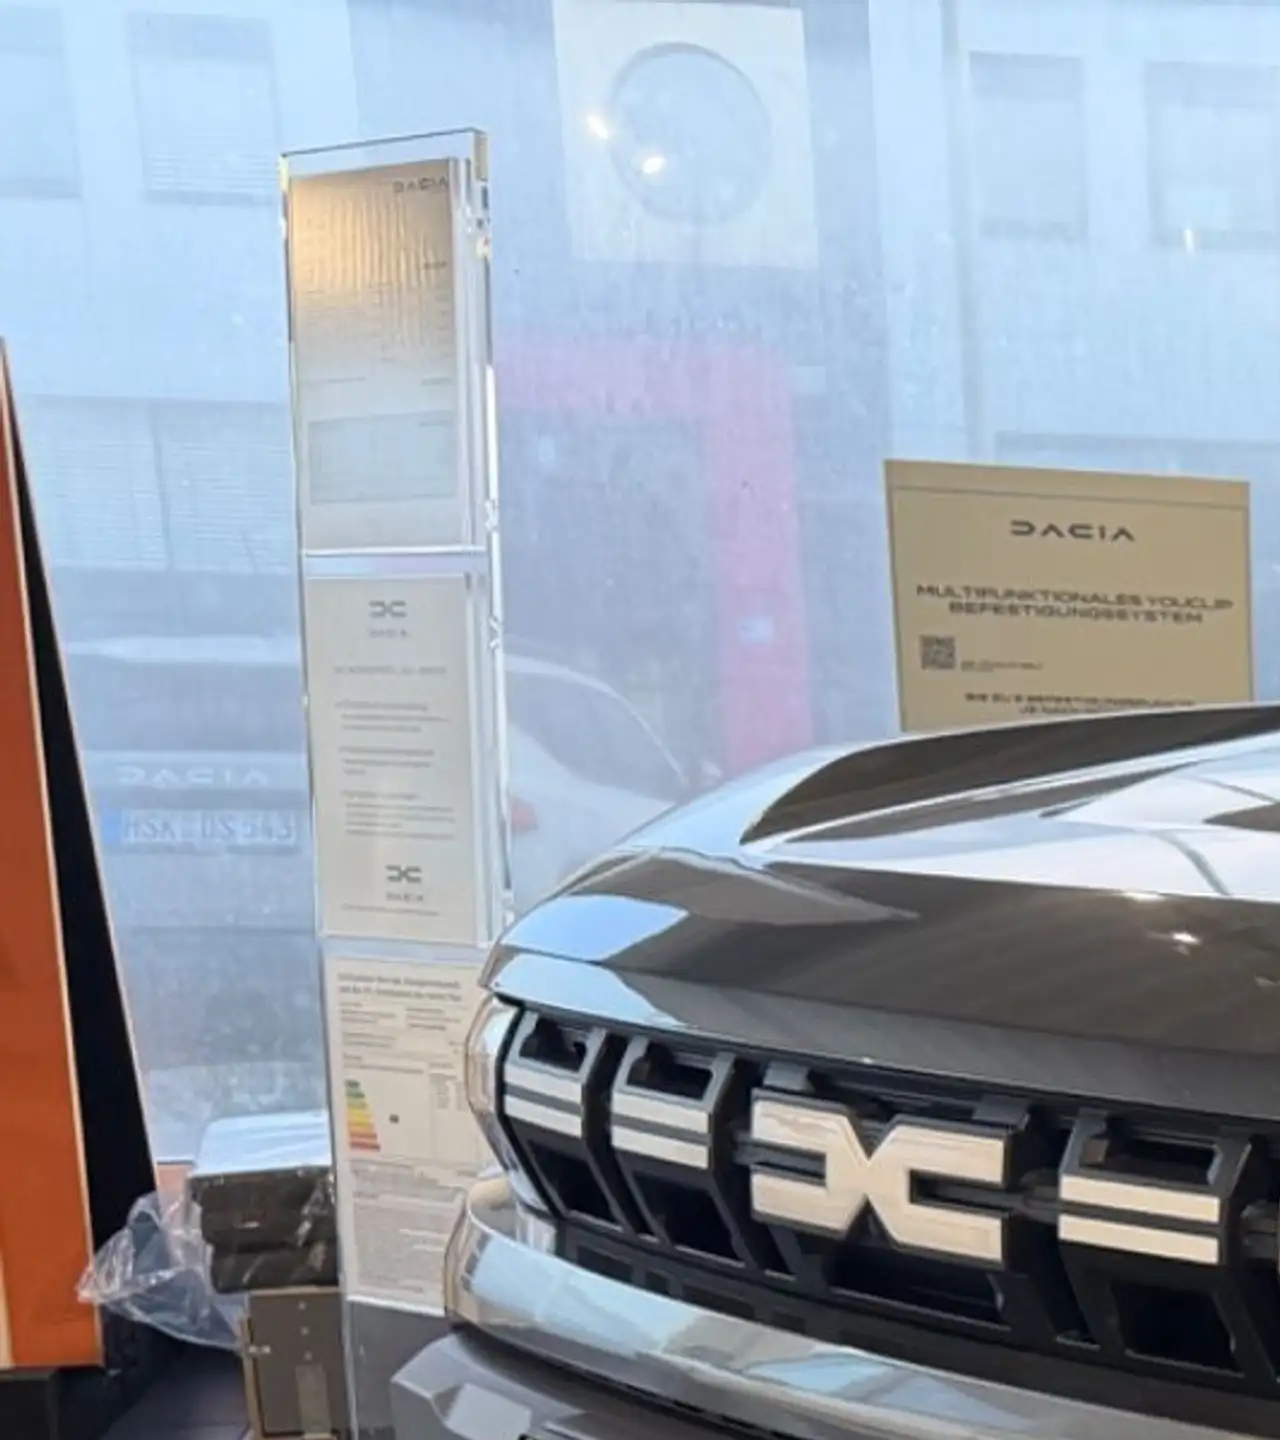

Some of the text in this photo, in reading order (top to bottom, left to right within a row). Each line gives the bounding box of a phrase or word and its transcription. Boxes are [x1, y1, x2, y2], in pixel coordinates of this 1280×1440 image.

[1009, 519, 1136, 542] DACIA
[916, 584, 1143, 607] MULTIFUNKTIONALES
[116, 765, 268, 787] DACIA
